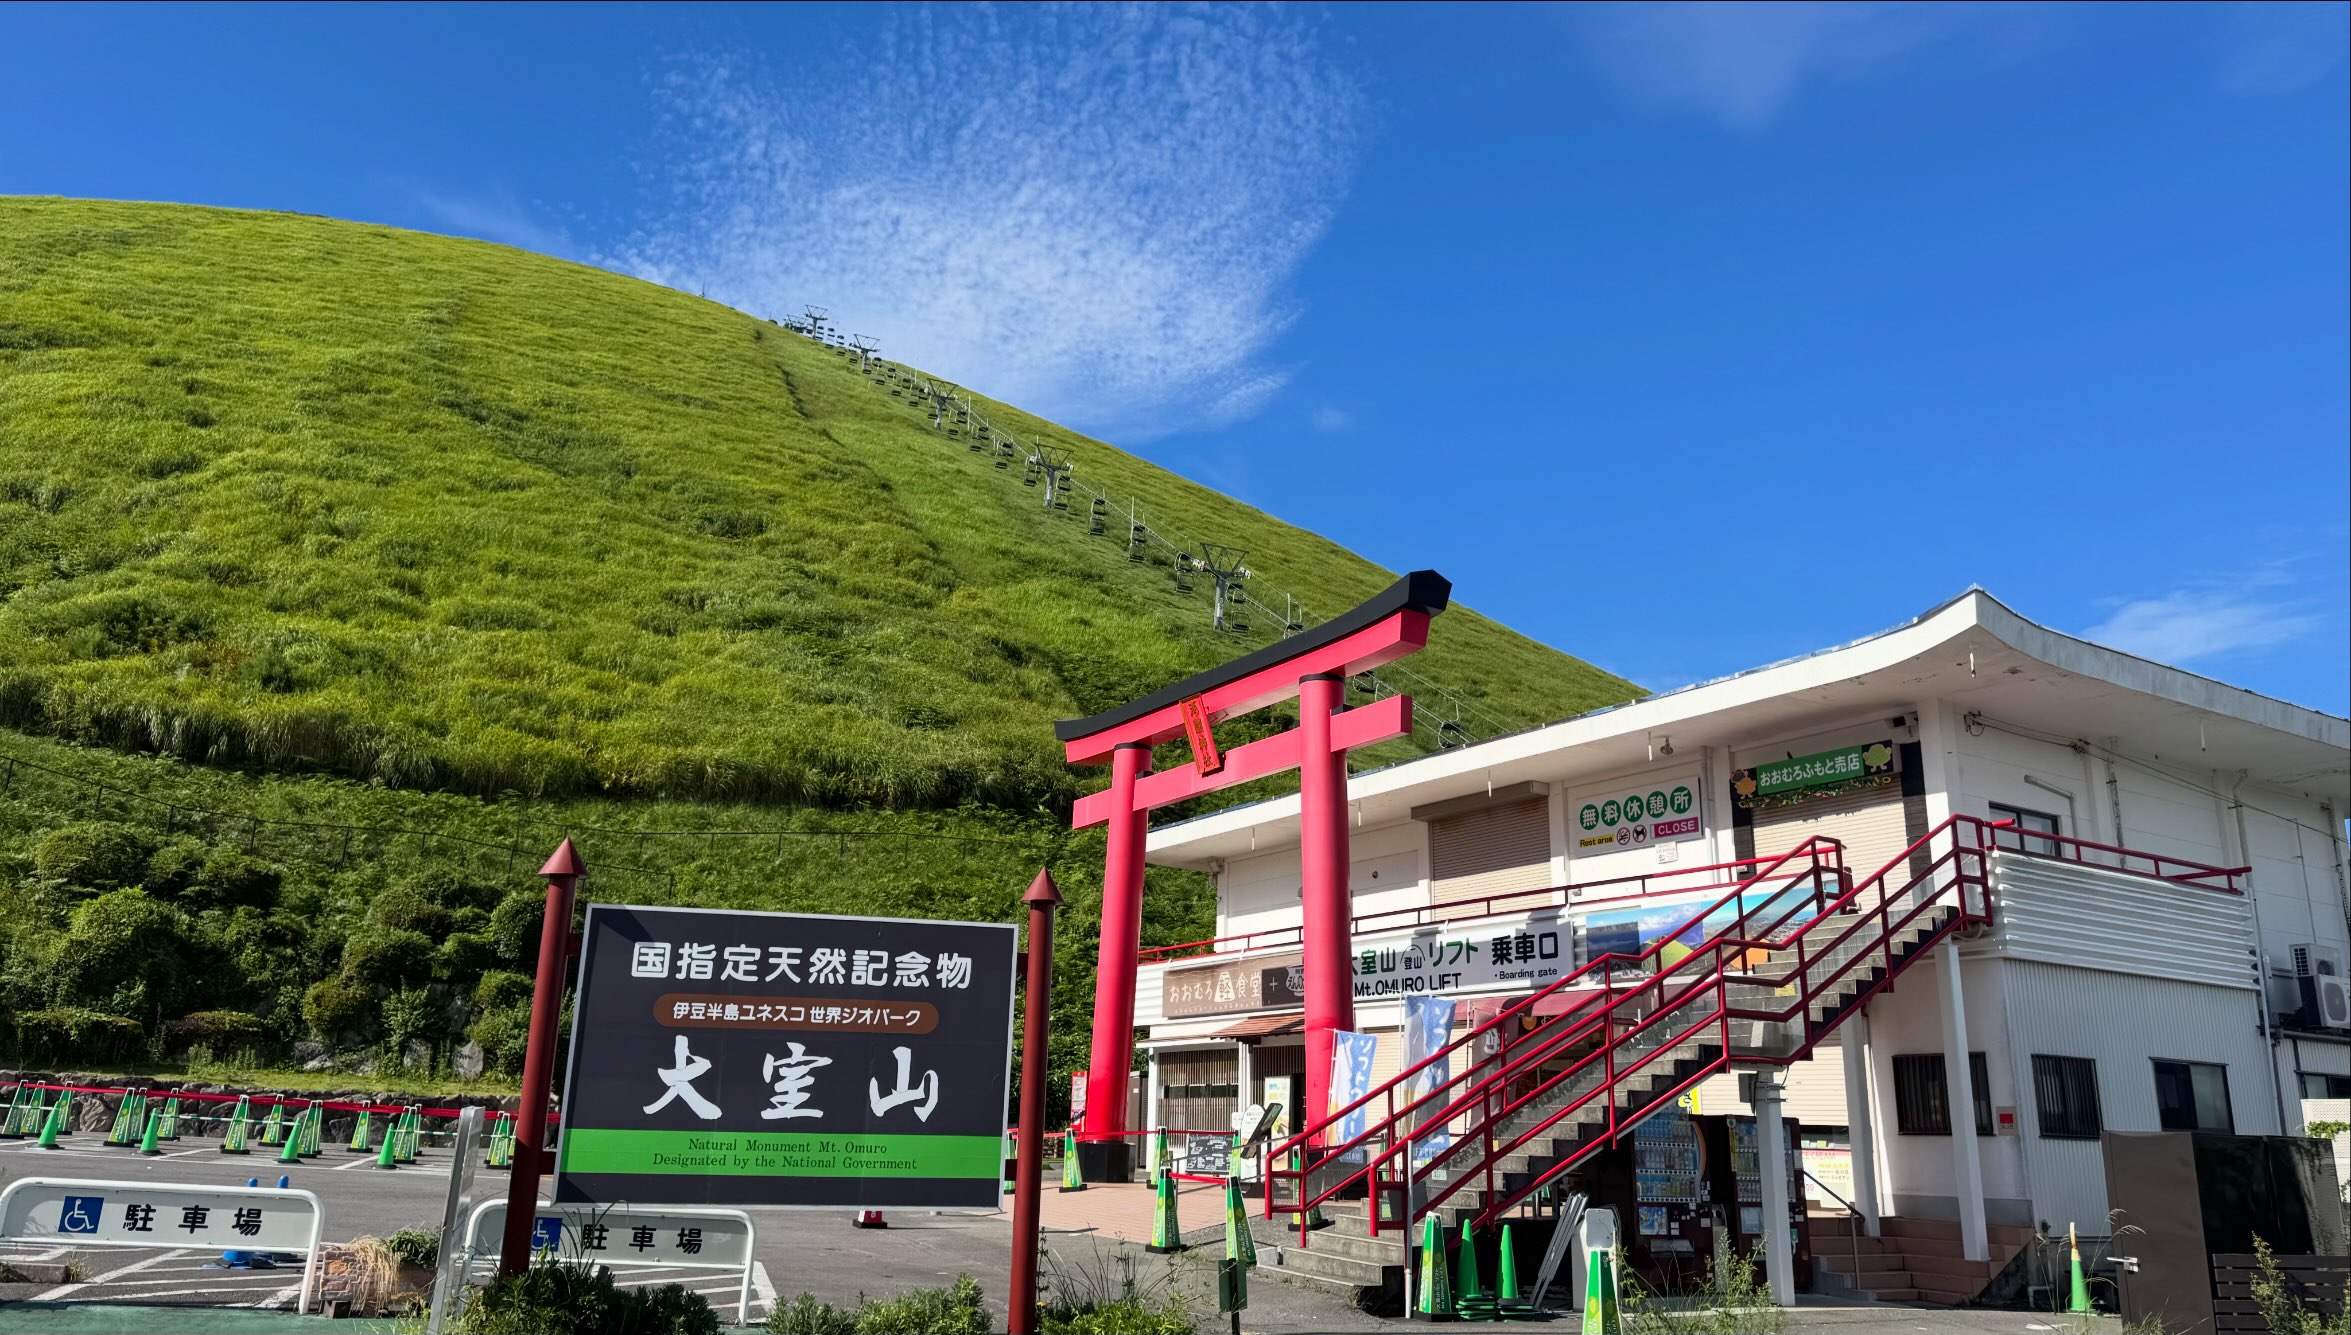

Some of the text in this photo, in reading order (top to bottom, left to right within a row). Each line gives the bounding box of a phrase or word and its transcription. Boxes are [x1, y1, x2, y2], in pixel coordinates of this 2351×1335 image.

[1759, 753, 1860, 787] おおむろふもと売店
[1582, 789, 1689, 827] 無料休憩所
[1580, 838, 1596, 847] Rest
[1658, 820, 1695, 835] CLOSE
[631, 941, 973, 989] 国指定天然記念物
[1429, 937, 1479, 967] リフト
[1491, 932, 1560, 966] 乗車口
[1169, 971, 1262, 1003] おおむろ軽食堂
[1429, 972, 1463, 991] LIFT
[1499, 967, 1558, 980] Boarding gate
[643, 1034, 939, 1122] 大室山
[652, 1152, 918, 1171] Designated by the National Government
[688, 1138, 887, 1154] Natural Monument Mt. Omuro
[123, 1203, 263, 1237] 駐車場
[583, 1223, 703, 1255] 駐車場
